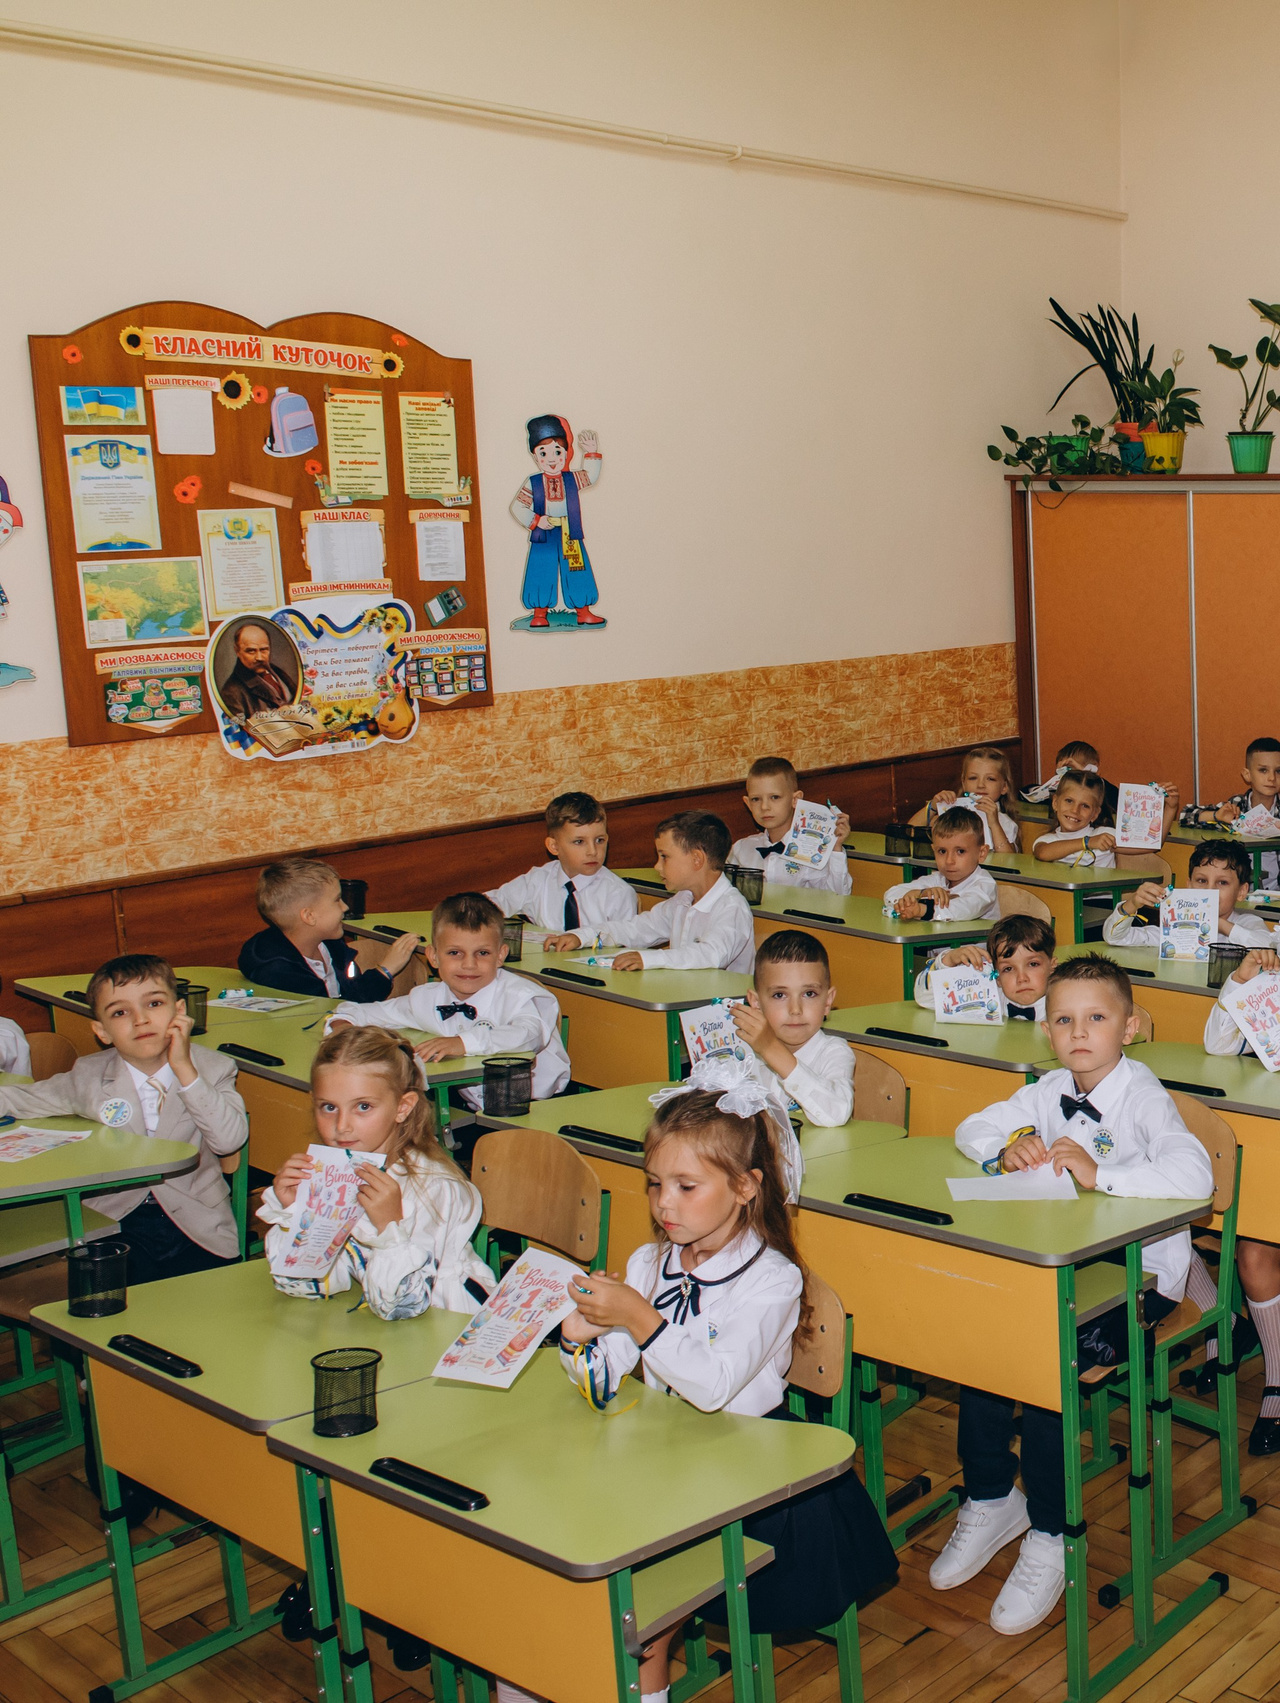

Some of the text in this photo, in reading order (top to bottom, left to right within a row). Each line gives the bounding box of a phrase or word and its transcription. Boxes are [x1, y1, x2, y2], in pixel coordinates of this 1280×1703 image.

[153, 335, 372, 373] КЛАСНИЙ КУТОЧОК
[148, 378, 217, 387] НАШІ ПЕРЕМОГИ
[314, 512, 370, 521] НАШ КЛАС
[419, 512, 460, 520] ДОРУЧЕННЯ
[292, 582, 389, 595] ВІТАННЯ ІМЕНИННИКАМ
[414, 633, 481, 643] ПОДОРОЖУЄМО
[456, 644, 486, 652] УЧНЯМ
[100, 651, 205, 668] МИ РОЗВАЖАЄМОСЬ
[1168, 908, 1206, 921] 1 КЛАСІ!
[955, 979, 979, 991] Вітаю
[948, 989, 990, 1006] 1 КЛАСІ!
[1246, 984, 1278, 1011] Вітаю
[1265, 997, 1280, 1014] 1
[700, 1022, 723, 1036] Вітаю
[695, 1033, 735, 1054] 1 КЛАСІ!
[325, 1165, 364, 1187] Вітаю
[335, 1184, 346, 1206] 1
[315, 1200, 356, 1220] КЛАСІ!
[519, 1269, 565, 1293] Вітаю
[520, 1288, 542, 1308] 1
[493, 1300, 544, 1323] КЛАСІ!
